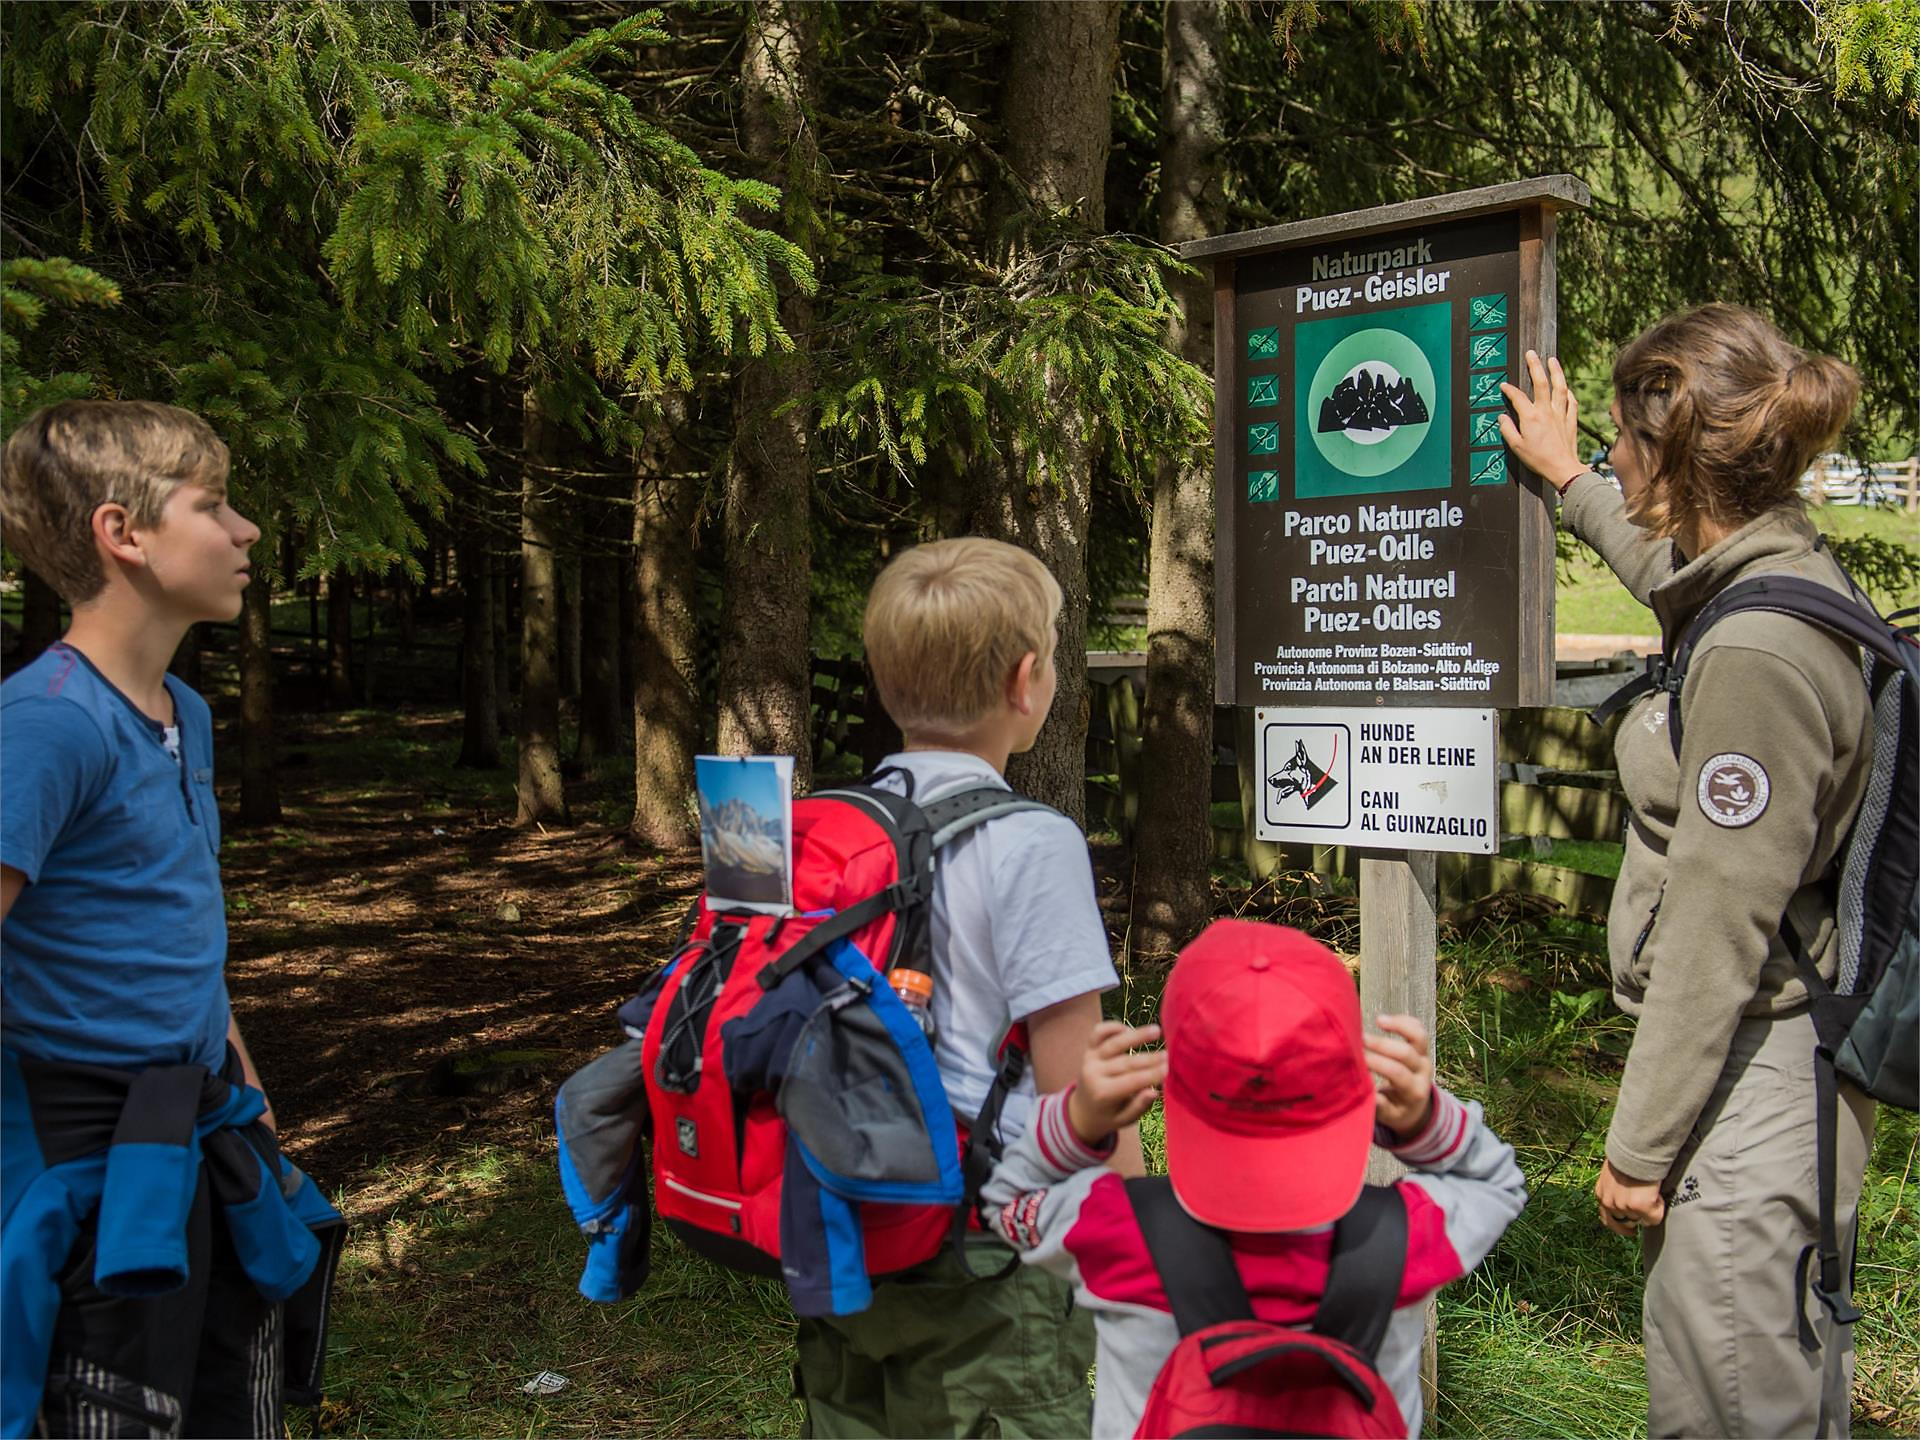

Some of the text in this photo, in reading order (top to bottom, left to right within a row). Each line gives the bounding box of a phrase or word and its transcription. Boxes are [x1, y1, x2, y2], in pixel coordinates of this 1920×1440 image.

[1312, 238, 1433, 282] Naturpark
[1296, 269, 1451, 314] Puez-Geisler
[1285, 500, 1463, 537] Parco Naturale
[1310, 534, 1434, 566] Puez-Odle
[1291, 571, 1456, 603] Parch Naturel
[1304, 604, 1442, 633] Puez-Odles
[1277, 642, 1472, 659] Autonome Provinz Bozen-Südtirol
[1254, 659, 1500, 676] Provincia Autonoma di Bolzano-Alto Adige
[1262, 677, 1490, 691] Provinzia Autonoma de Balsan-Südtirol
[1361, 724, 1415, 742] HUNDE
[1361, 746, 1476, 766] AN DER LEINE
[1361, 790, 1399, 809] CANI
[1361, 813, 1487, 837] AL GUINZAGLIO
